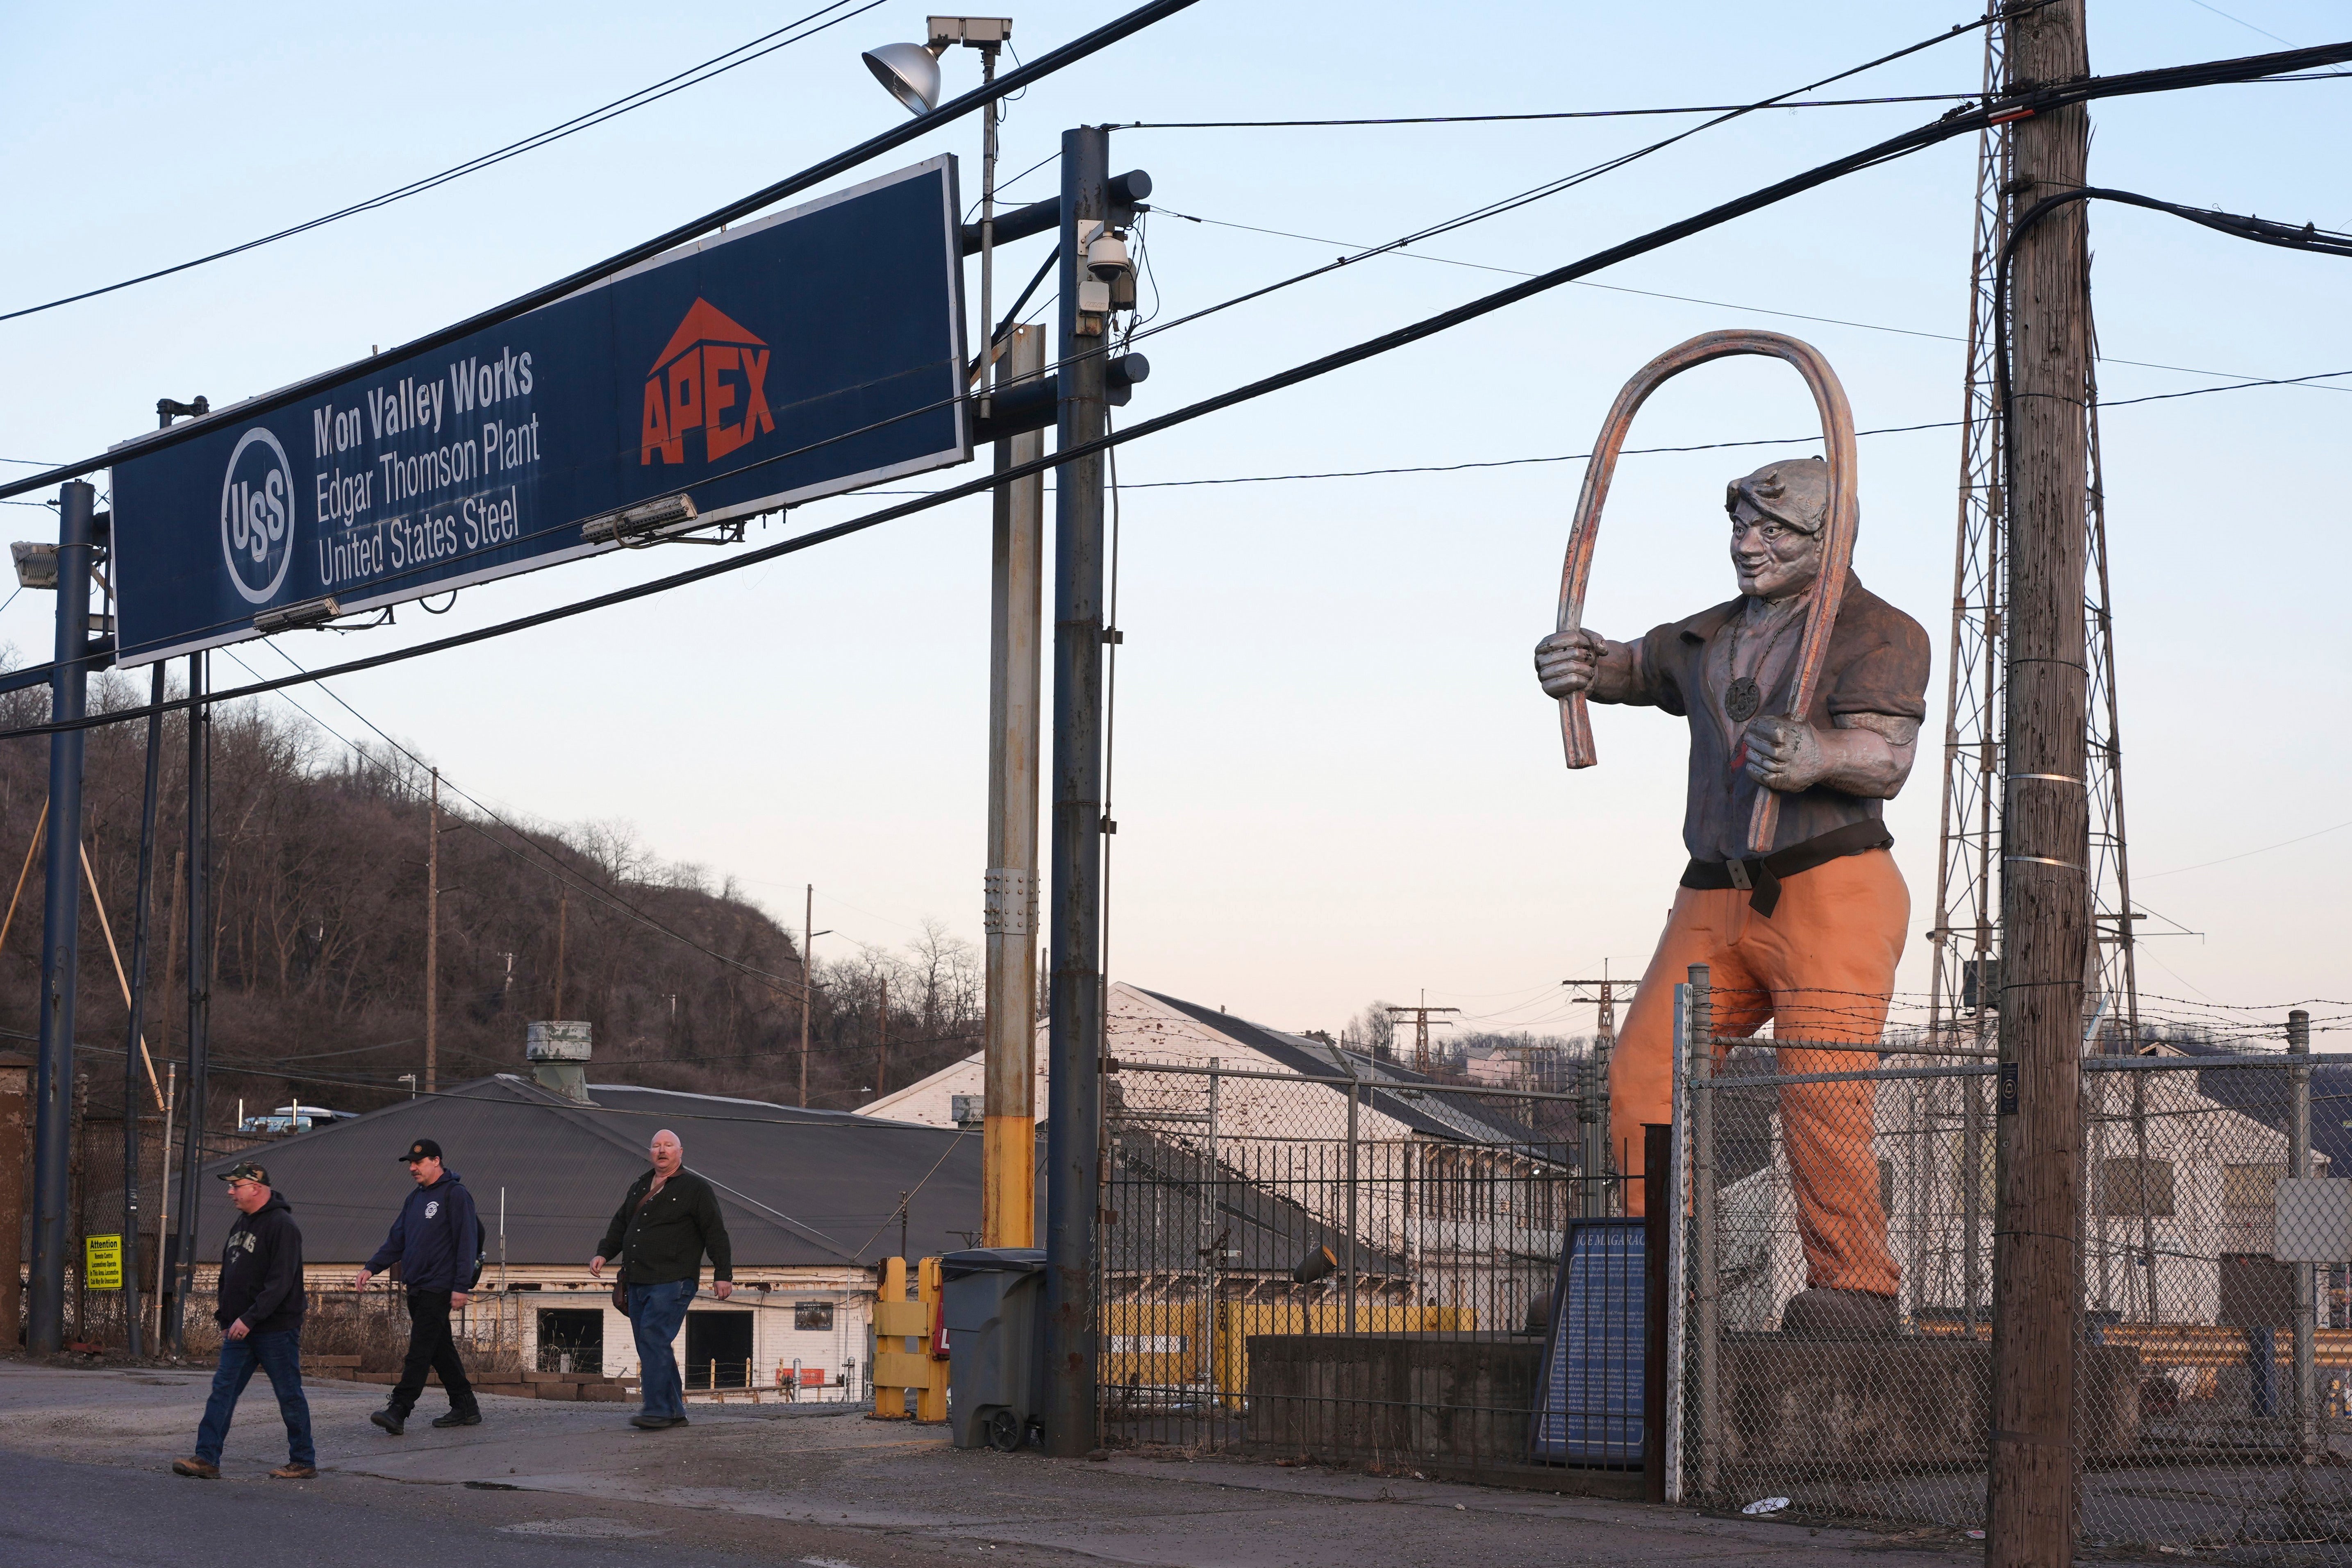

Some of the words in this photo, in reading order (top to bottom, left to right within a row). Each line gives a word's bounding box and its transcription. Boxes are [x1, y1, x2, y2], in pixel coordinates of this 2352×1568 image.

[314, 404, 363, 458] Mon
[367, 377, 444, 440] Valley
[450, 346, 533, 414] Works
[641, 339, 775, 466] APEX
[232, 468, 284, 563] USS
[317, 470, 374, 526] Edgar
[379, 439, 477, 504] Thomson
[484, 412, 540, 475] Plant
[319, 521, 384, 586] United
[391, 512, 457, 568] States
[464, 486, 519, 549] Steel
[1729, 685, 1757, 712] USS
[90, 1239, 117, 1249] Attention
